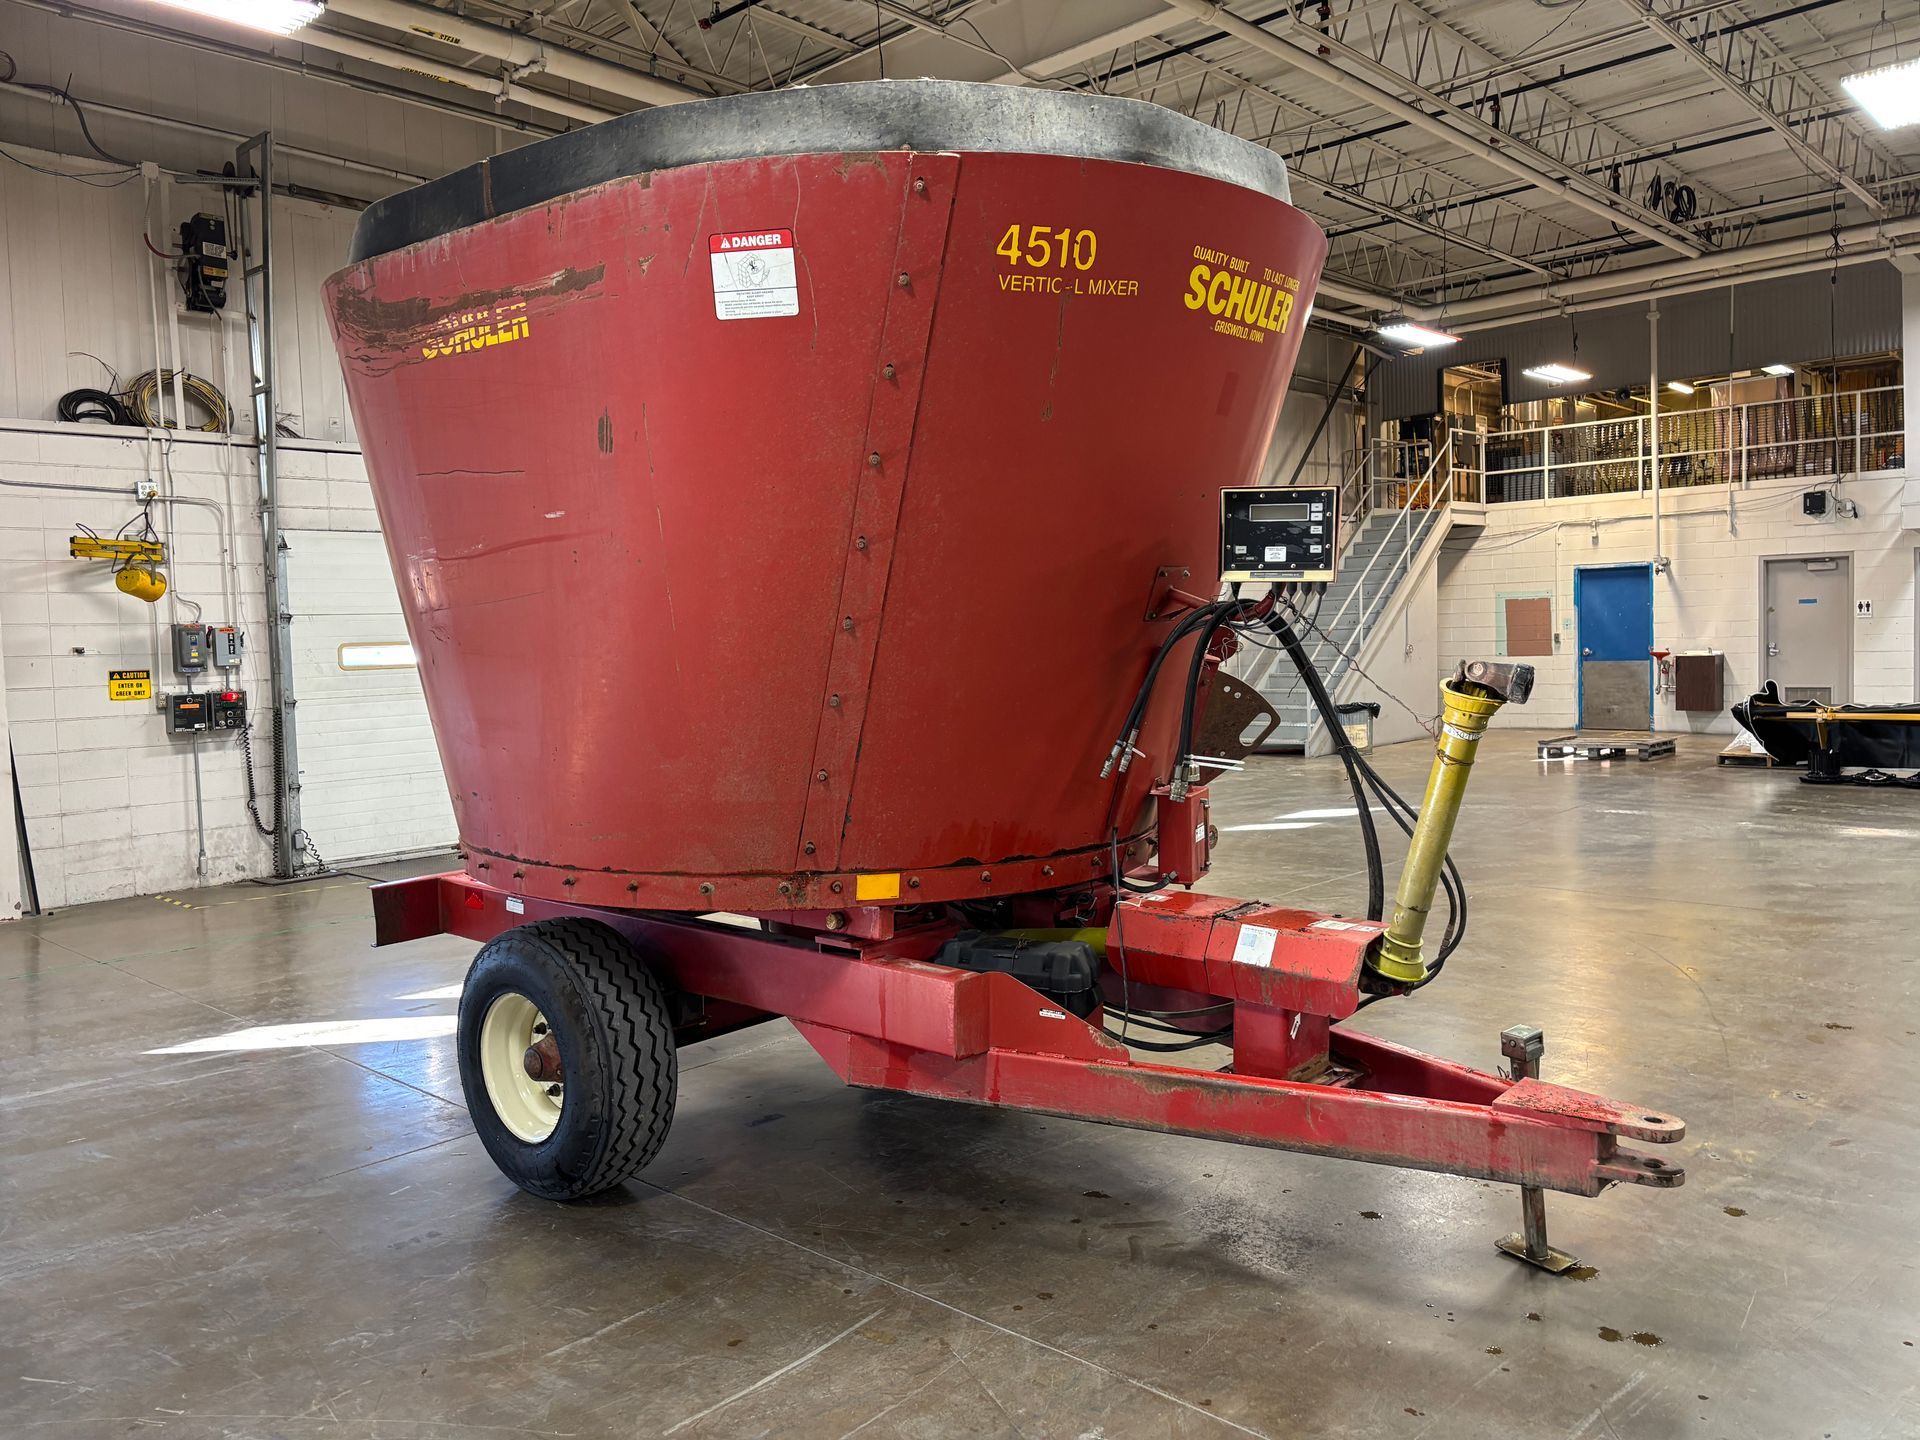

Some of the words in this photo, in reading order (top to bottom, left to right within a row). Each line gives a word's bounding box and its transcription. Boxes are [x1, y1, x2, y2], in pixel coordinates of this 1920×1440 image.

[439, 34, 461, 44] STEAM
[731, 233, 782, 248] DANGER
[996, 224, 1097, 271] 4510
[1193, 245, 1229, 267] QUALITY
[1229, 256, 1250, 273] BUILT
[998, 274, 1083, 294] VERTICL
[1088, 279, 1139, 296] MIXER
[1263, 267, 1272, 281] TO
[1271, 271, 1285, 286] LAST
[1184, 264, 1294, 334] SCHULER
[1214, 319, 1249, 340] GRISWOLD,
[1248, 329, 1265, 344] IOWA
